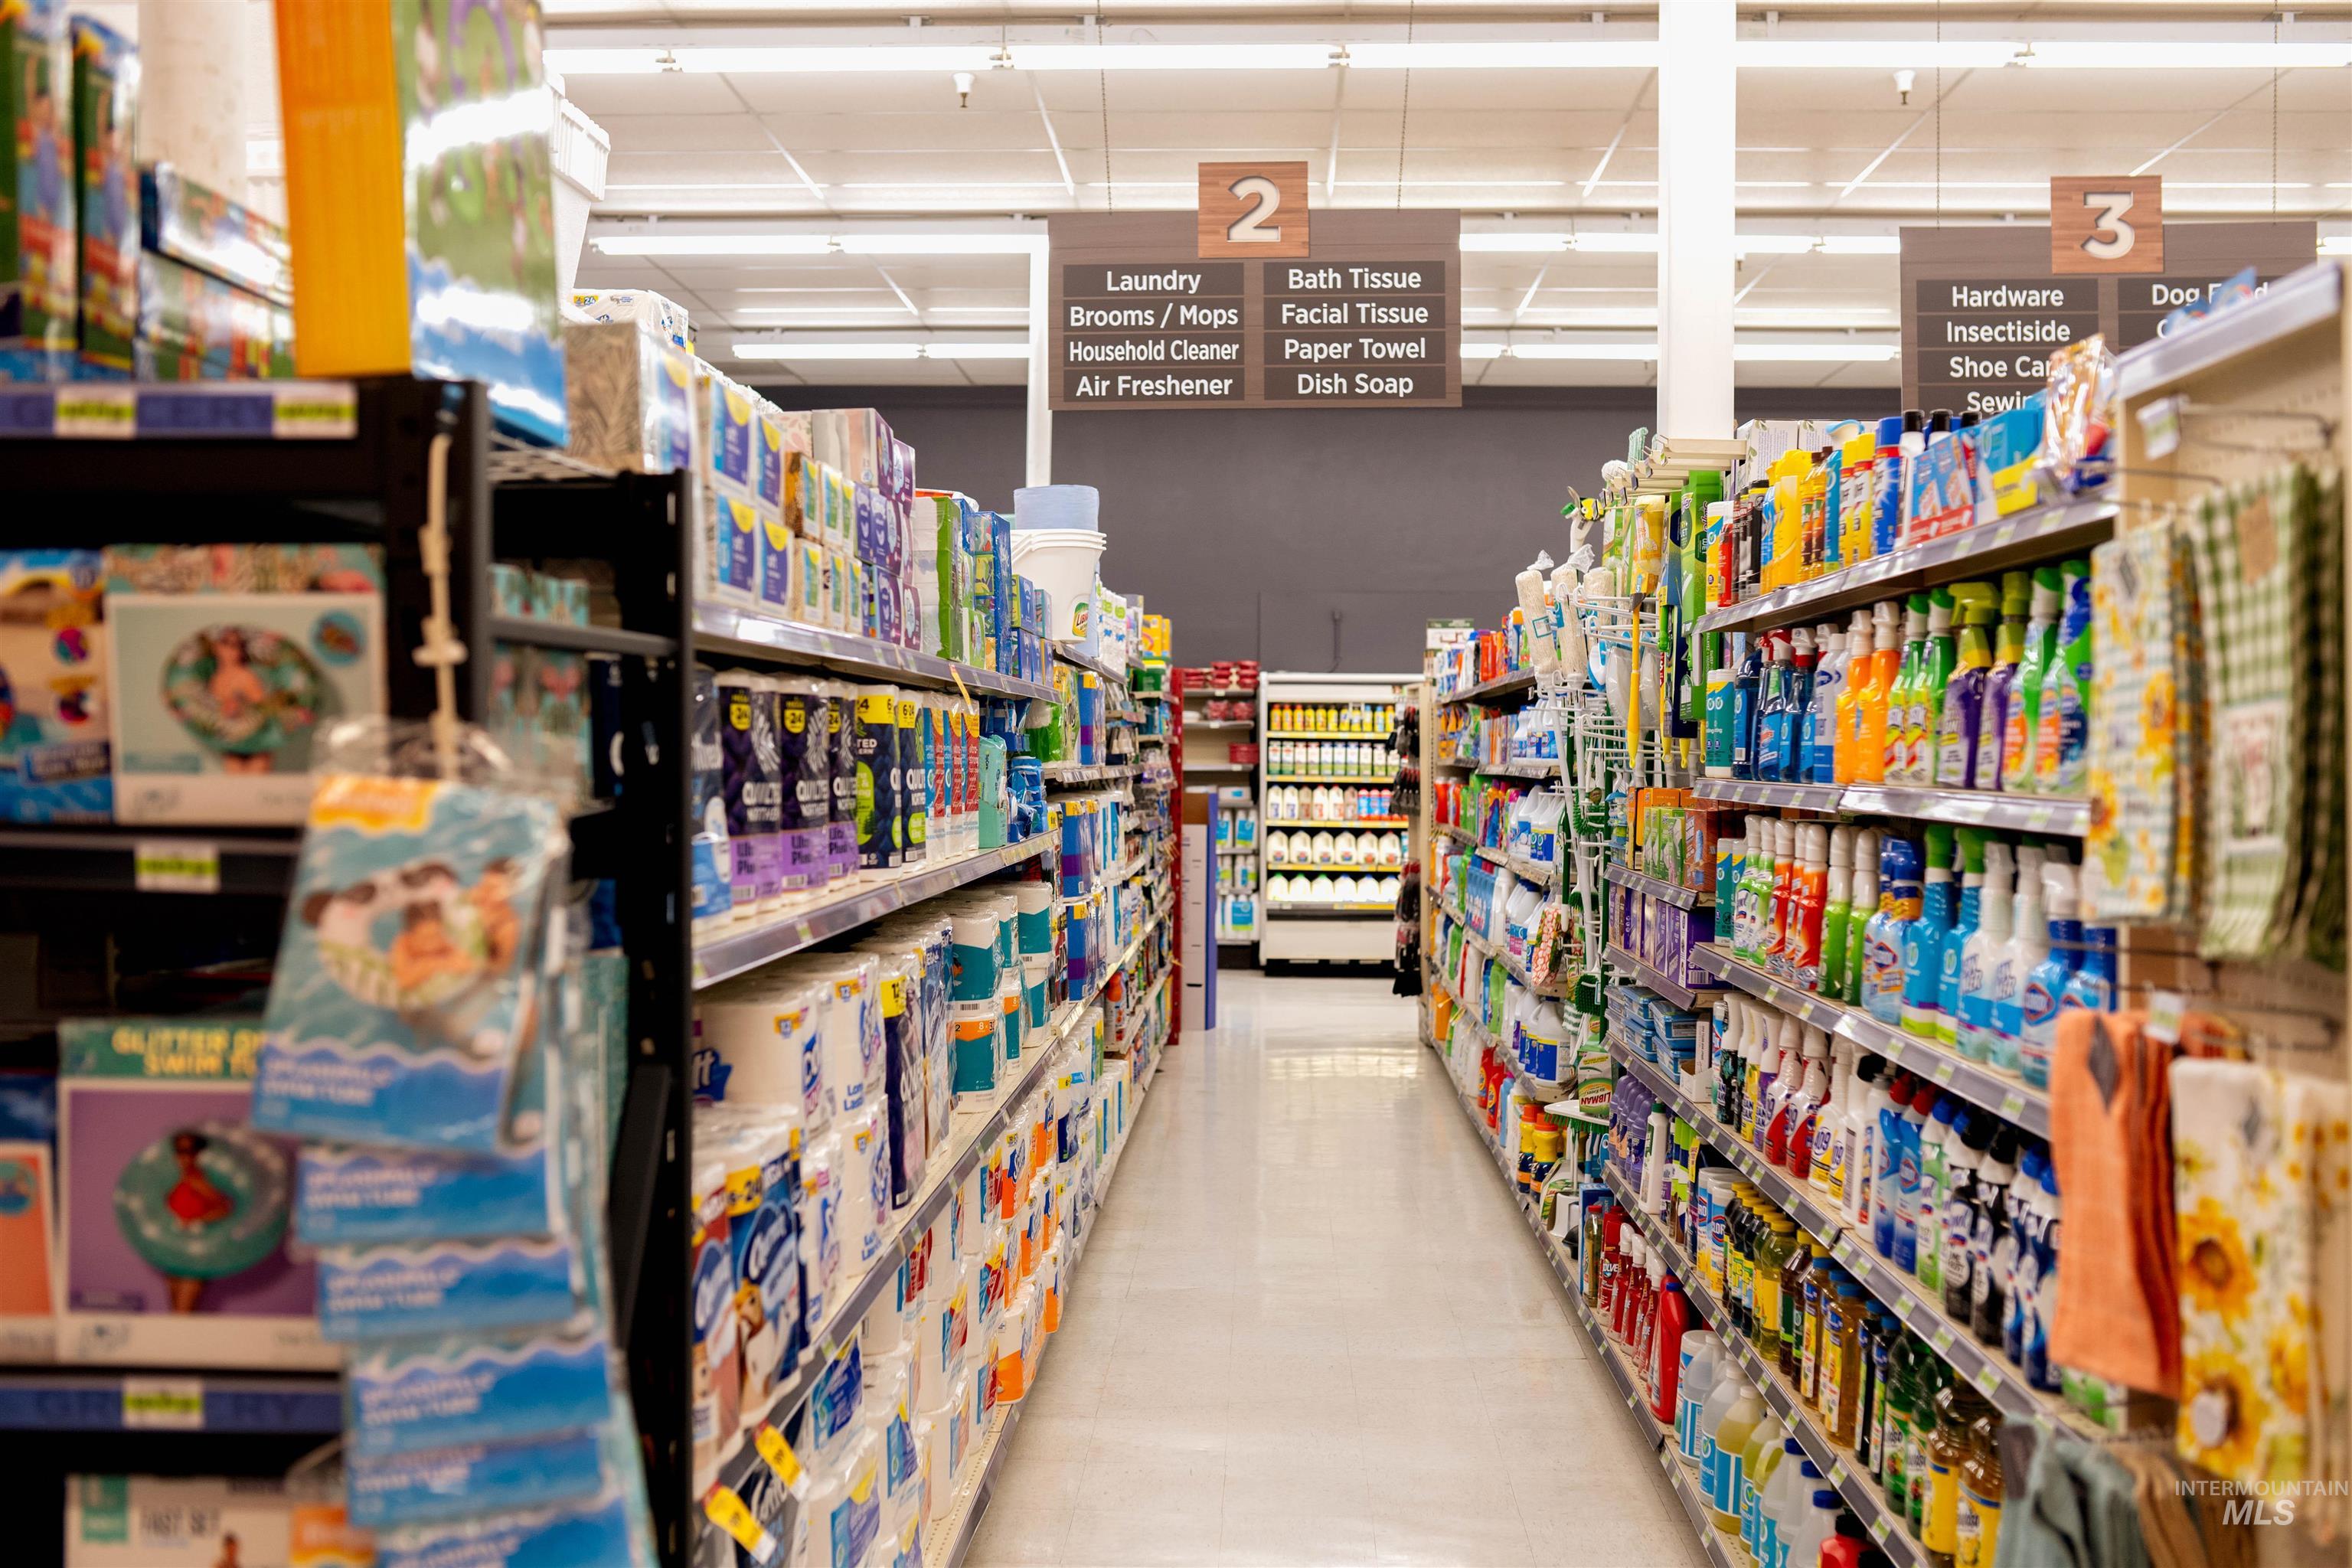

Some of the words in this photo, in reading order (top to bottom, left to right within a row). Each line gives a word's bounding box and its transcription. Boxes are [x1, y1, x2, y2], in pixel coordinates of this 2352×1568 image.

[1227, 175, 1281, 243] 2
[2080, 190, 2135, 260] 3
[1107, 270, 1201, 294] Laundry
[1289, 268, 1341, 289] Bath
[1349, 268, 1421, 288] Tissue
[1952, 286, 2063, 307] Hardware
[1070, 306, 1155, 326] Brooms
[1160, 303, 1173, 328] /
[1181, 305, 1238, 328] Mops
[1282, 303, 1348, 324] Facial
[1356, 303, 1428, 323] Tissue
[1948, 320, 2070, 342] Insectiside
[1070, 340, 1165, 361] Household
[1171, 340, 1239, 360] Cleaner
[1285, 339, 1352, 362] Paper
[1359, 338, 1425, 358] Towel
[1949, 356, 2007, 378] Shoe
[2015, 355, 2051, 377] Car
[1076, 376, 1110, 396] Air
[1118, 375, 1233, 395] Freshener
[1298, 374, 1347, 394] Dish
[1355, 374, 1413, 397] Soap
[1967, 390, 2034, 413] Sewi
[1581, 1092, 1611, 1105] LIBMAN
[1814, 1131, 1831, 1152] 409
